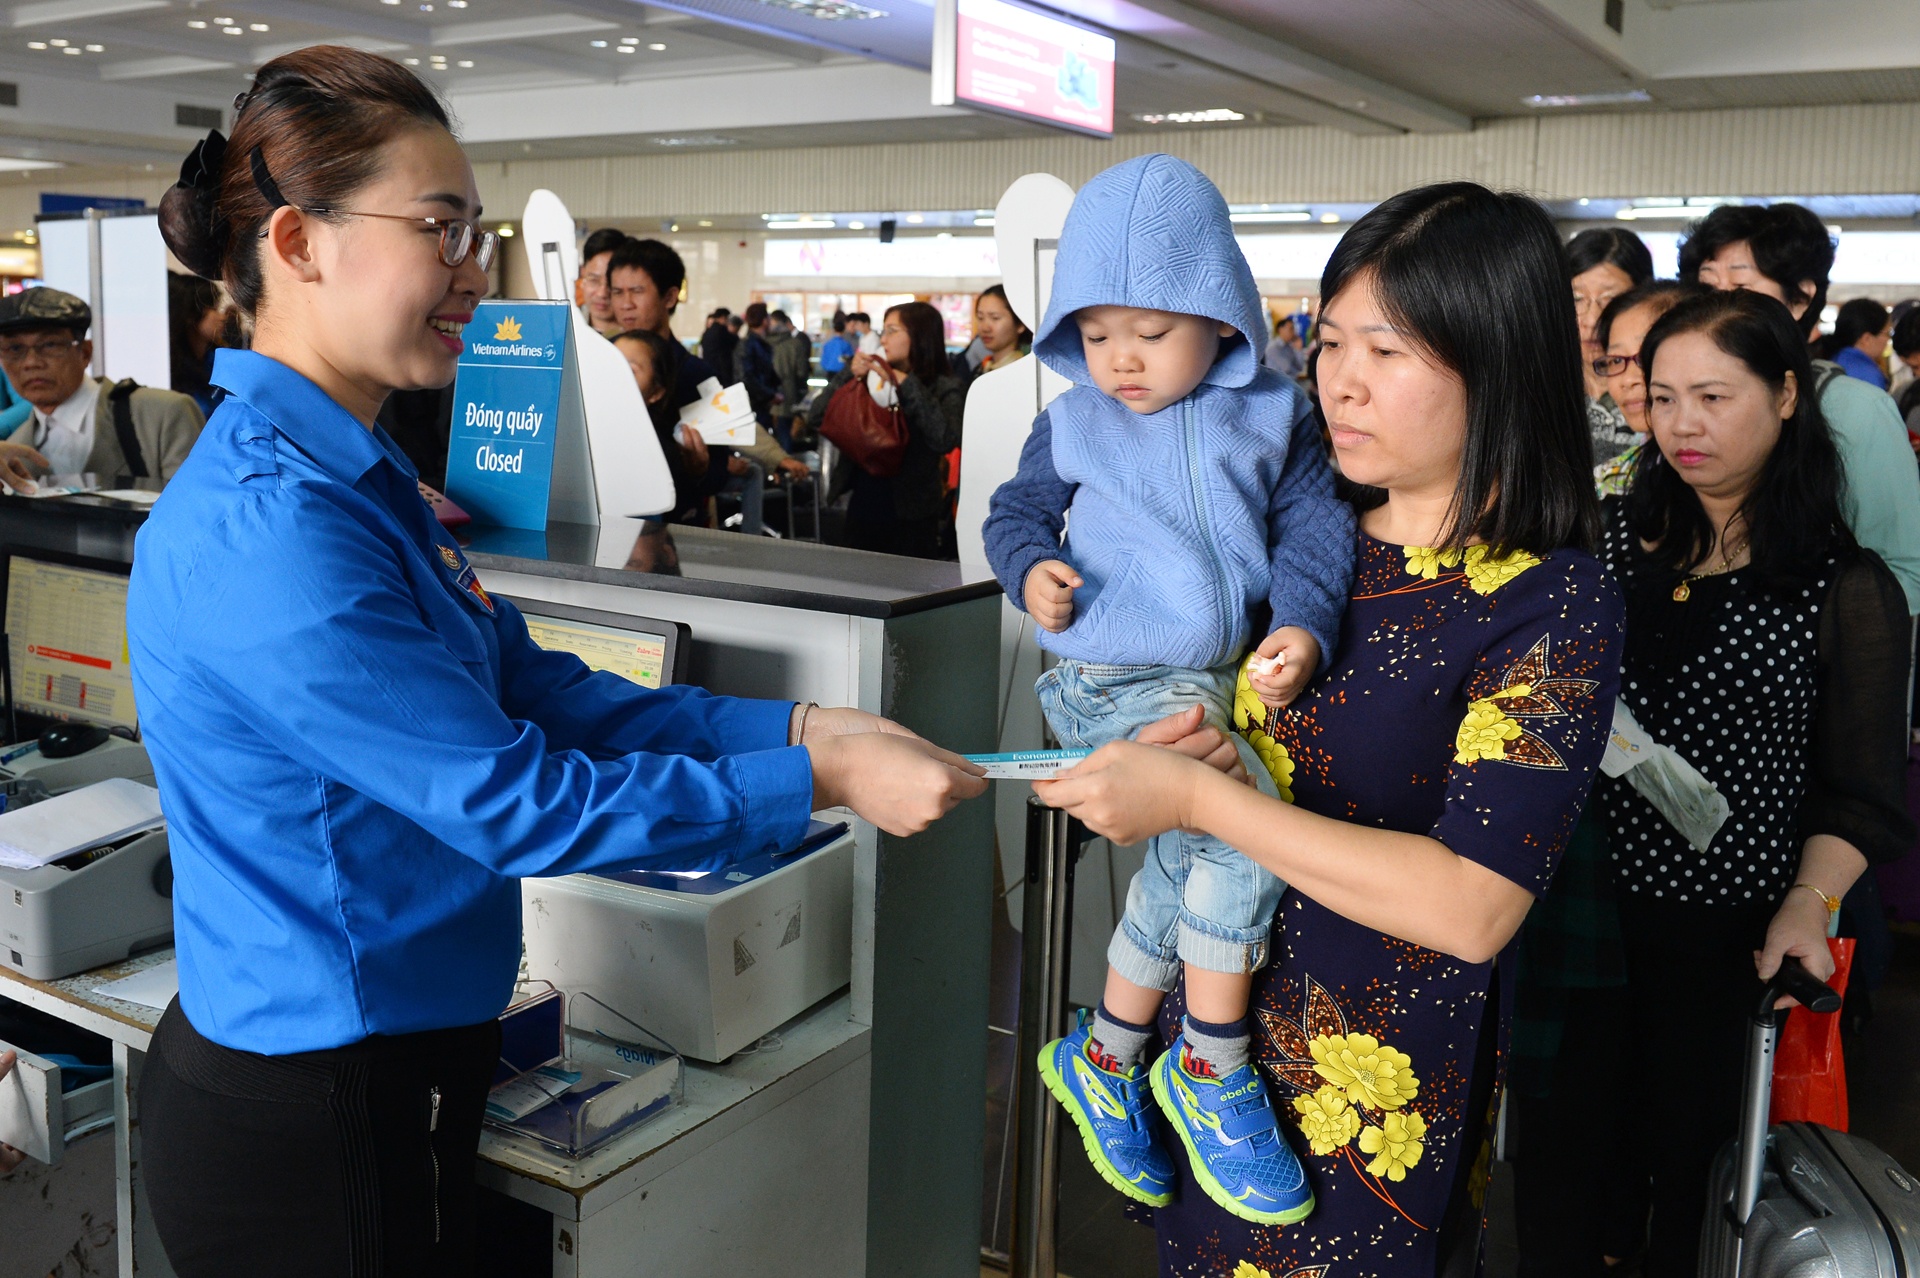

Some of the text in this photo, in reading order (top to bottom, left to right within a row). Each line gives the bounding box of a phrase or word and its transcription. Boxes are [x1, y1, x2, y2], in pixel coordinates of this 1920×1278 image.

[465, 402, 544, 438] Đóng quầy
[476, 445, 524, 474] Closed
[1012, 750, 1086, 761] Economy Class
